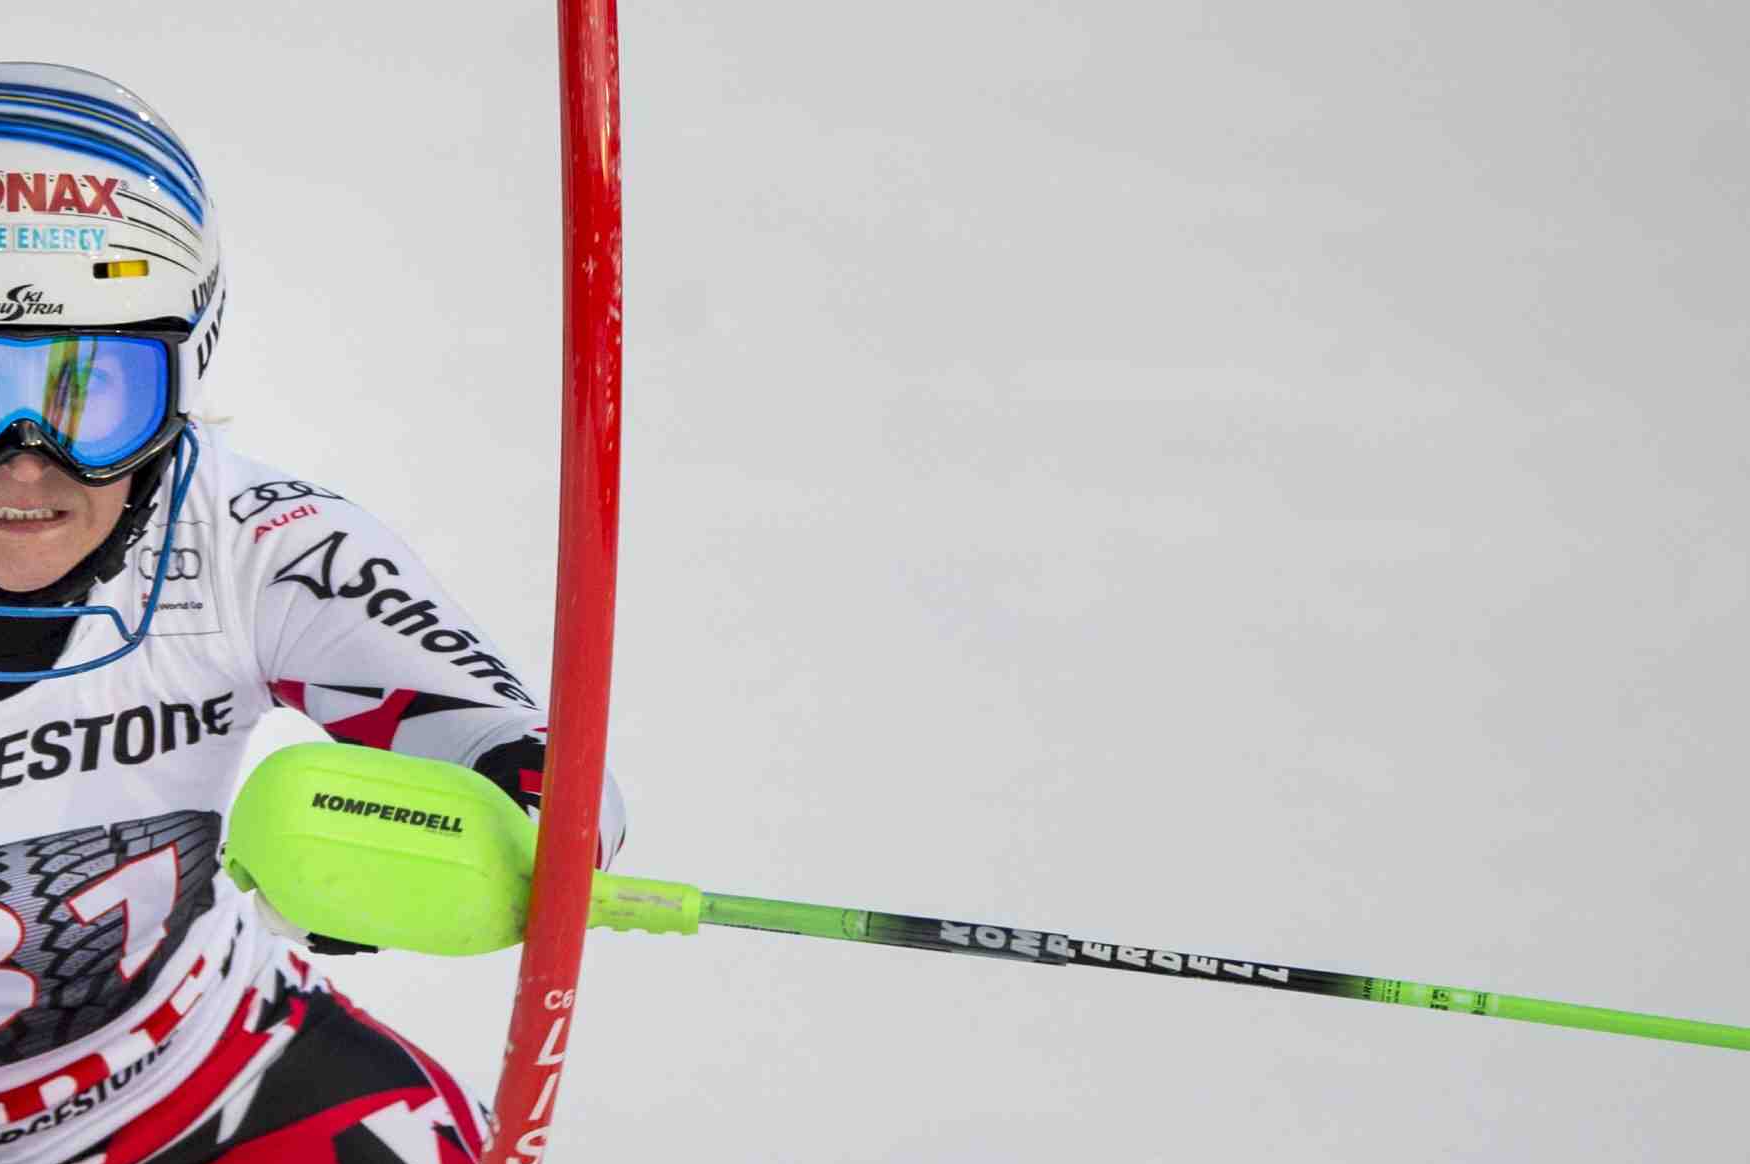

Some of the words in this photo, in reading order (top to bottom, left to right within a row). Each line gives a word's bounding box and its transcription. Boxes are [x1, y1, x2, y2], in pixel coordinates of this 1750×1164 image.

[17, 226, 106, 250] ENERGY
[253, 503, 318, 545] Audi
[312, 792, 464, 833] KOMPERDELL
